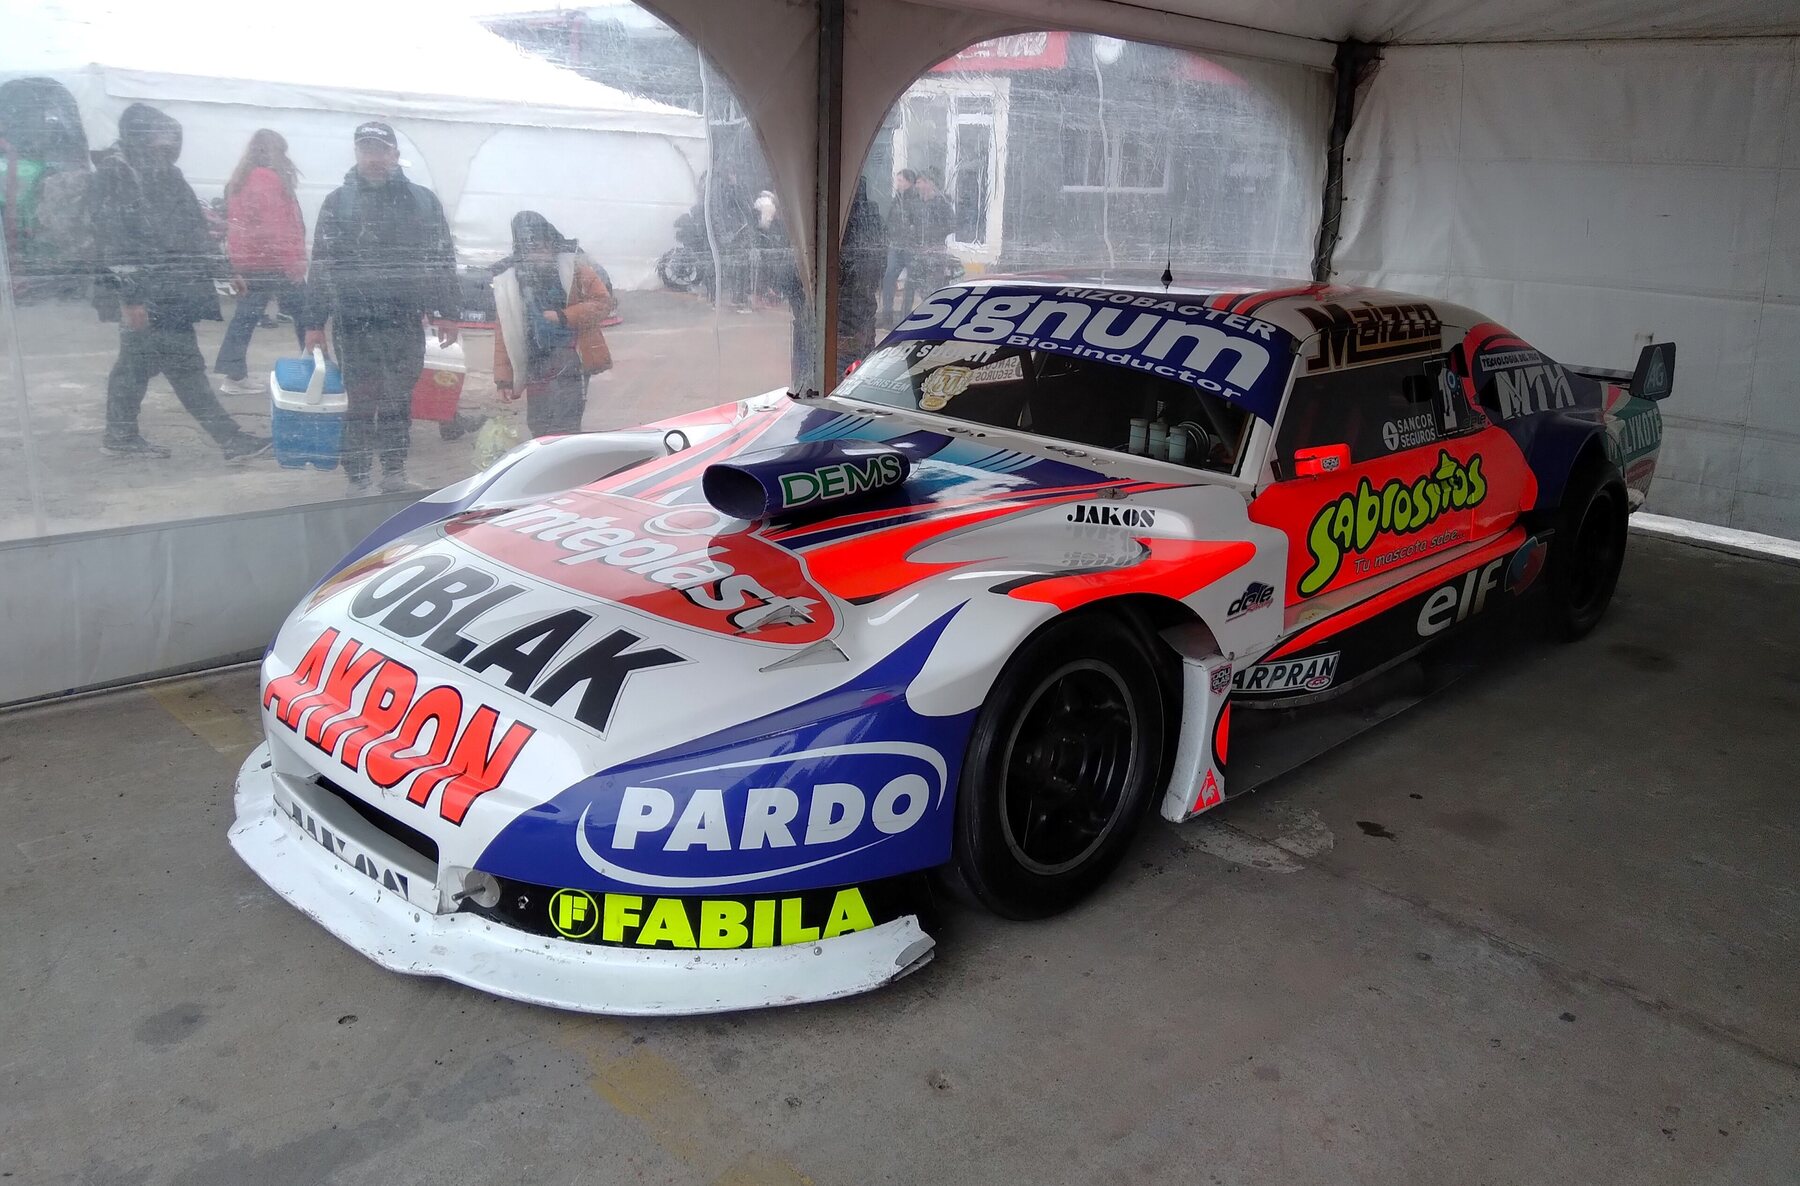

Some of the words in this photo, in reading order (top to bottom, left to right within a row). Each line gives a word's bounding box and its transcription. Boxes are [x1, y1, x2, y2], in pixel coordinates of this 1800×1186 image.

[896, 286, 1271, 391] Signum
[1056, 287, 1277, 341] RIZOBACTER
[1006, 334, 1242, 398] Bio-inductor
[1397, 413, 1434, 433] SANCOR
[1400, 428, 1436, 449] SEGUROS
[782, 453, 904, 507] DEMS
[1066, 504, 1156, 528] JAKOS
[1355, 559, 1371, 573] Tu
[1374, 540, 1427, 568] mascota
[1416, 557, 1504, 638] elf
[351, 554, 688, 733] OBLAK
[263, 626, 538, 828] AKRON
[611, 773, 930, 852] PARDO
[602, 887, 875, 950] FABILA
